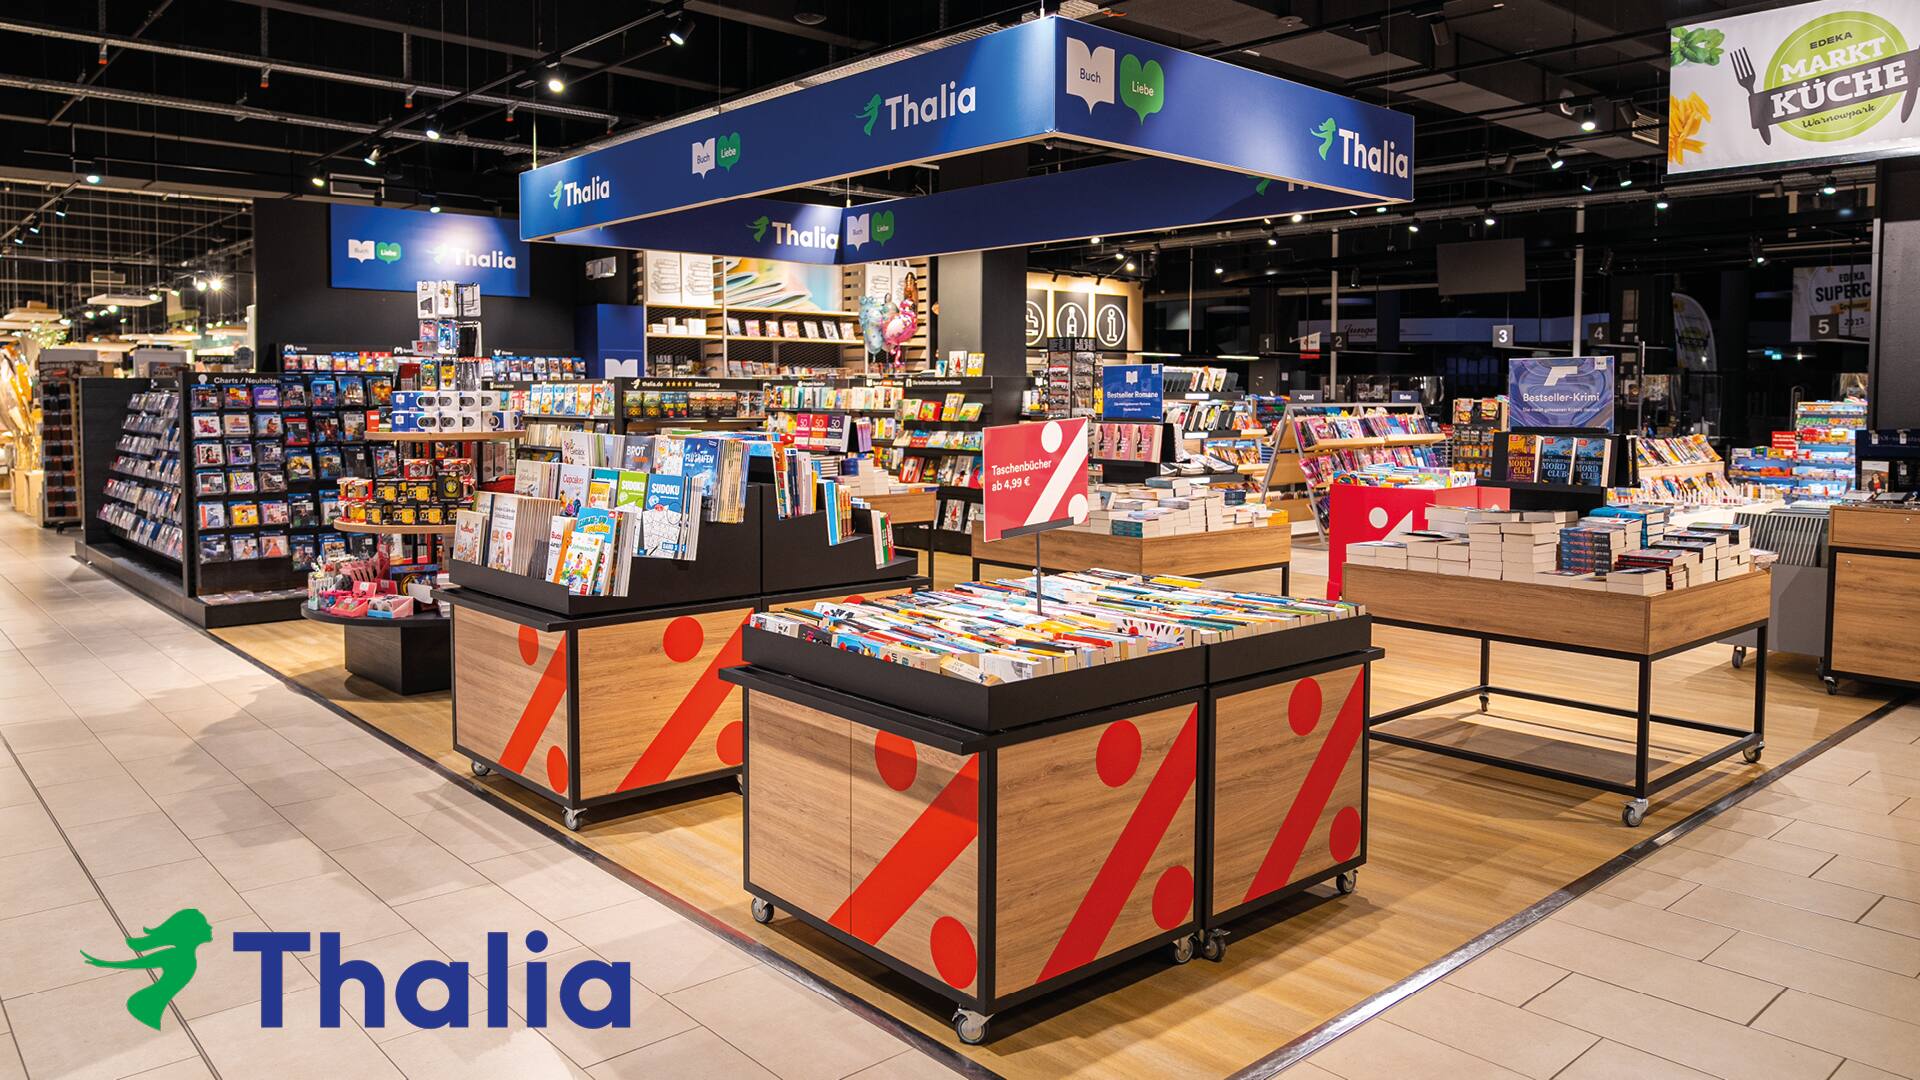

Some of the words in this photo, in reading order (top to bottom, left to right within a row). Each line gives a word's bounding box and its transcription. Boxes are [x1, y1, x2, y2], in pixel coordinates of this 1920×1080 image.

[1809, 31, 1853, 50] EDEKA
[1780, 36, 1886, 82] MARKT
[1079, 67, 1101, 83] Buch
[1131, 80, 1154, 97] Liebe
[1770, 59, 1908, 118] KÜCHE
[885, 80, 976, 130] Thalia
[1801, 103, 1877, 128] Warnowpark
[696, 153, 711, 165] Buch
[720, 146, 737, 159] Liebe
[1338, 128, 1409, 179] Thalia
[563, 175, 610, 207] Thalia
[771, 221, 840, 250] Thalia
[380, 248, 397, 257] Liebe
[454, 250, 516, 269] Thalia
[1815, 282, 1871, 303] SUPERC
[1594, 326, 1604, 340] 4
[1817, 319, 1830, 335] 5
[1264, 337, 1270, 349] 1
[1335, 335, 1343, 348] 2
[1498, 329, 1508, 343] 3
[1106, 391, 1134, 400] Bestseller
[1134, 390, 1159, 399] Romane
[1522, 392, 1600, 403] Bestseller-Krimi
[799, 418, 808, 428] 50
[815, 418, 824, 428] 50
[831, 419, 841, 429] 50
[626, 445, 646, 456] BROT
[991, 459, 1053, 477] Taschenbücher
[1541, 462, 1566, 470] MORD
[651, 483, 680, 496] SUDOKU
[991, 480, 1003, 492] ab
[1003, 477, 1023, 491] 4,99
[1023, 476, 1031, 487] €
